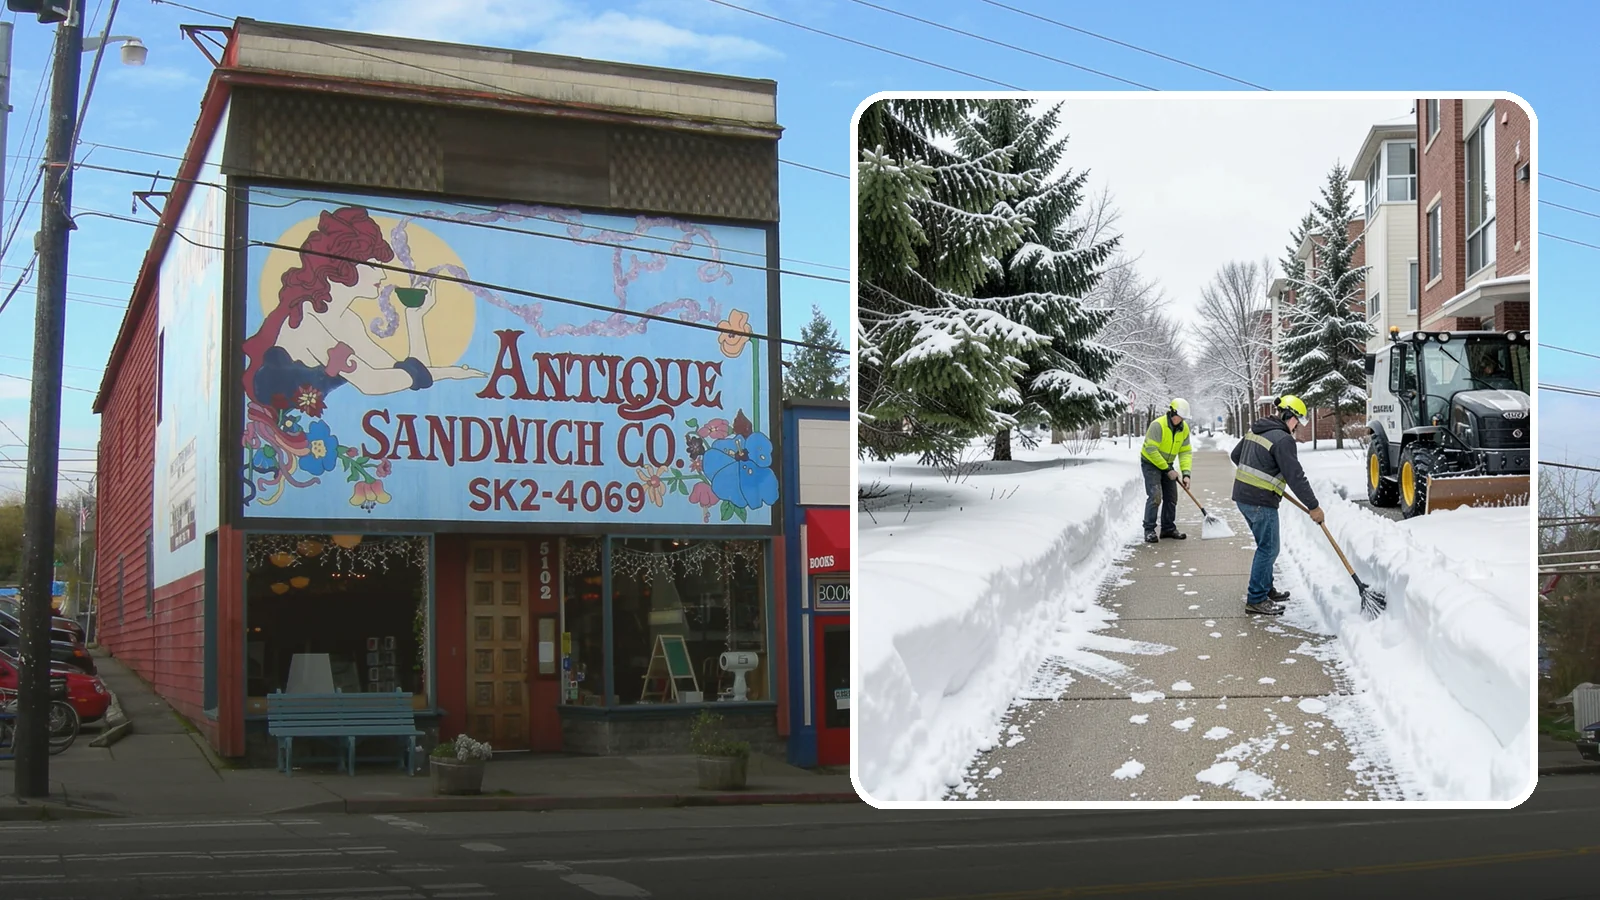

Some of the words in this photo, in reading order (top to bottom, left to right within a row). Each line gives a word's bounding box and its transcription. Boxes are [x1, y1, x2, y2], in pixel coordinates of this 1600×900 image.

[477, 330, 723, 420] ANTIQUE
[362, 409, 604, 467] SANDWICH
[617, 421, 686, 469] CO.
[468, 477, 646, 514] SK2-4069
[540, 542, 552, 599] 5102
[809, 555, 835, 569] BOOKS
